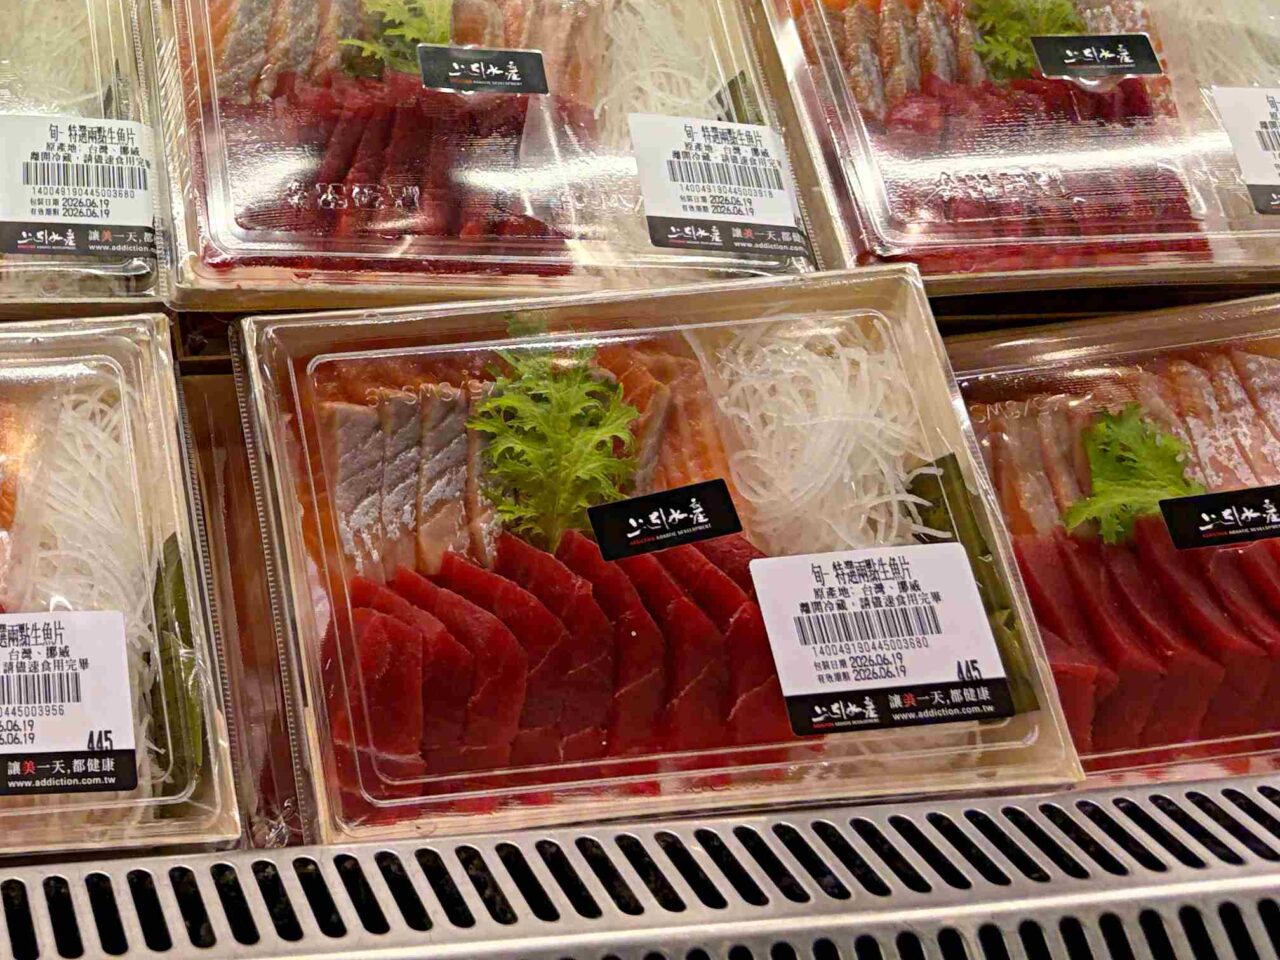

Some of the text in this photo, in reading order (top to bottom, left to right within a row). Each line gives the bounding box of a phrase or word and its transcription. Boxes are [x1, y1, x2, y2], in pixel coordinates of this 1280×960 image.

[62, 198, 109, 208] 2026.06.19
[710, 195, 752, 206] 2026.06.19
[62, 208, 110, 218] 2026.06.19
[711, 205, 754, 216] 2026.06.19
[849, 652, 903, 668] 2026.06.19
[852, 665, 906, 682] 2026.06.19
[957, 660, 983, 681] 445
[892, 704, 994, 721] www.addiction.com.tw
[87, 730, 113, 750] 445
[8, 776, 116, 788] www.addiction.com.tw
